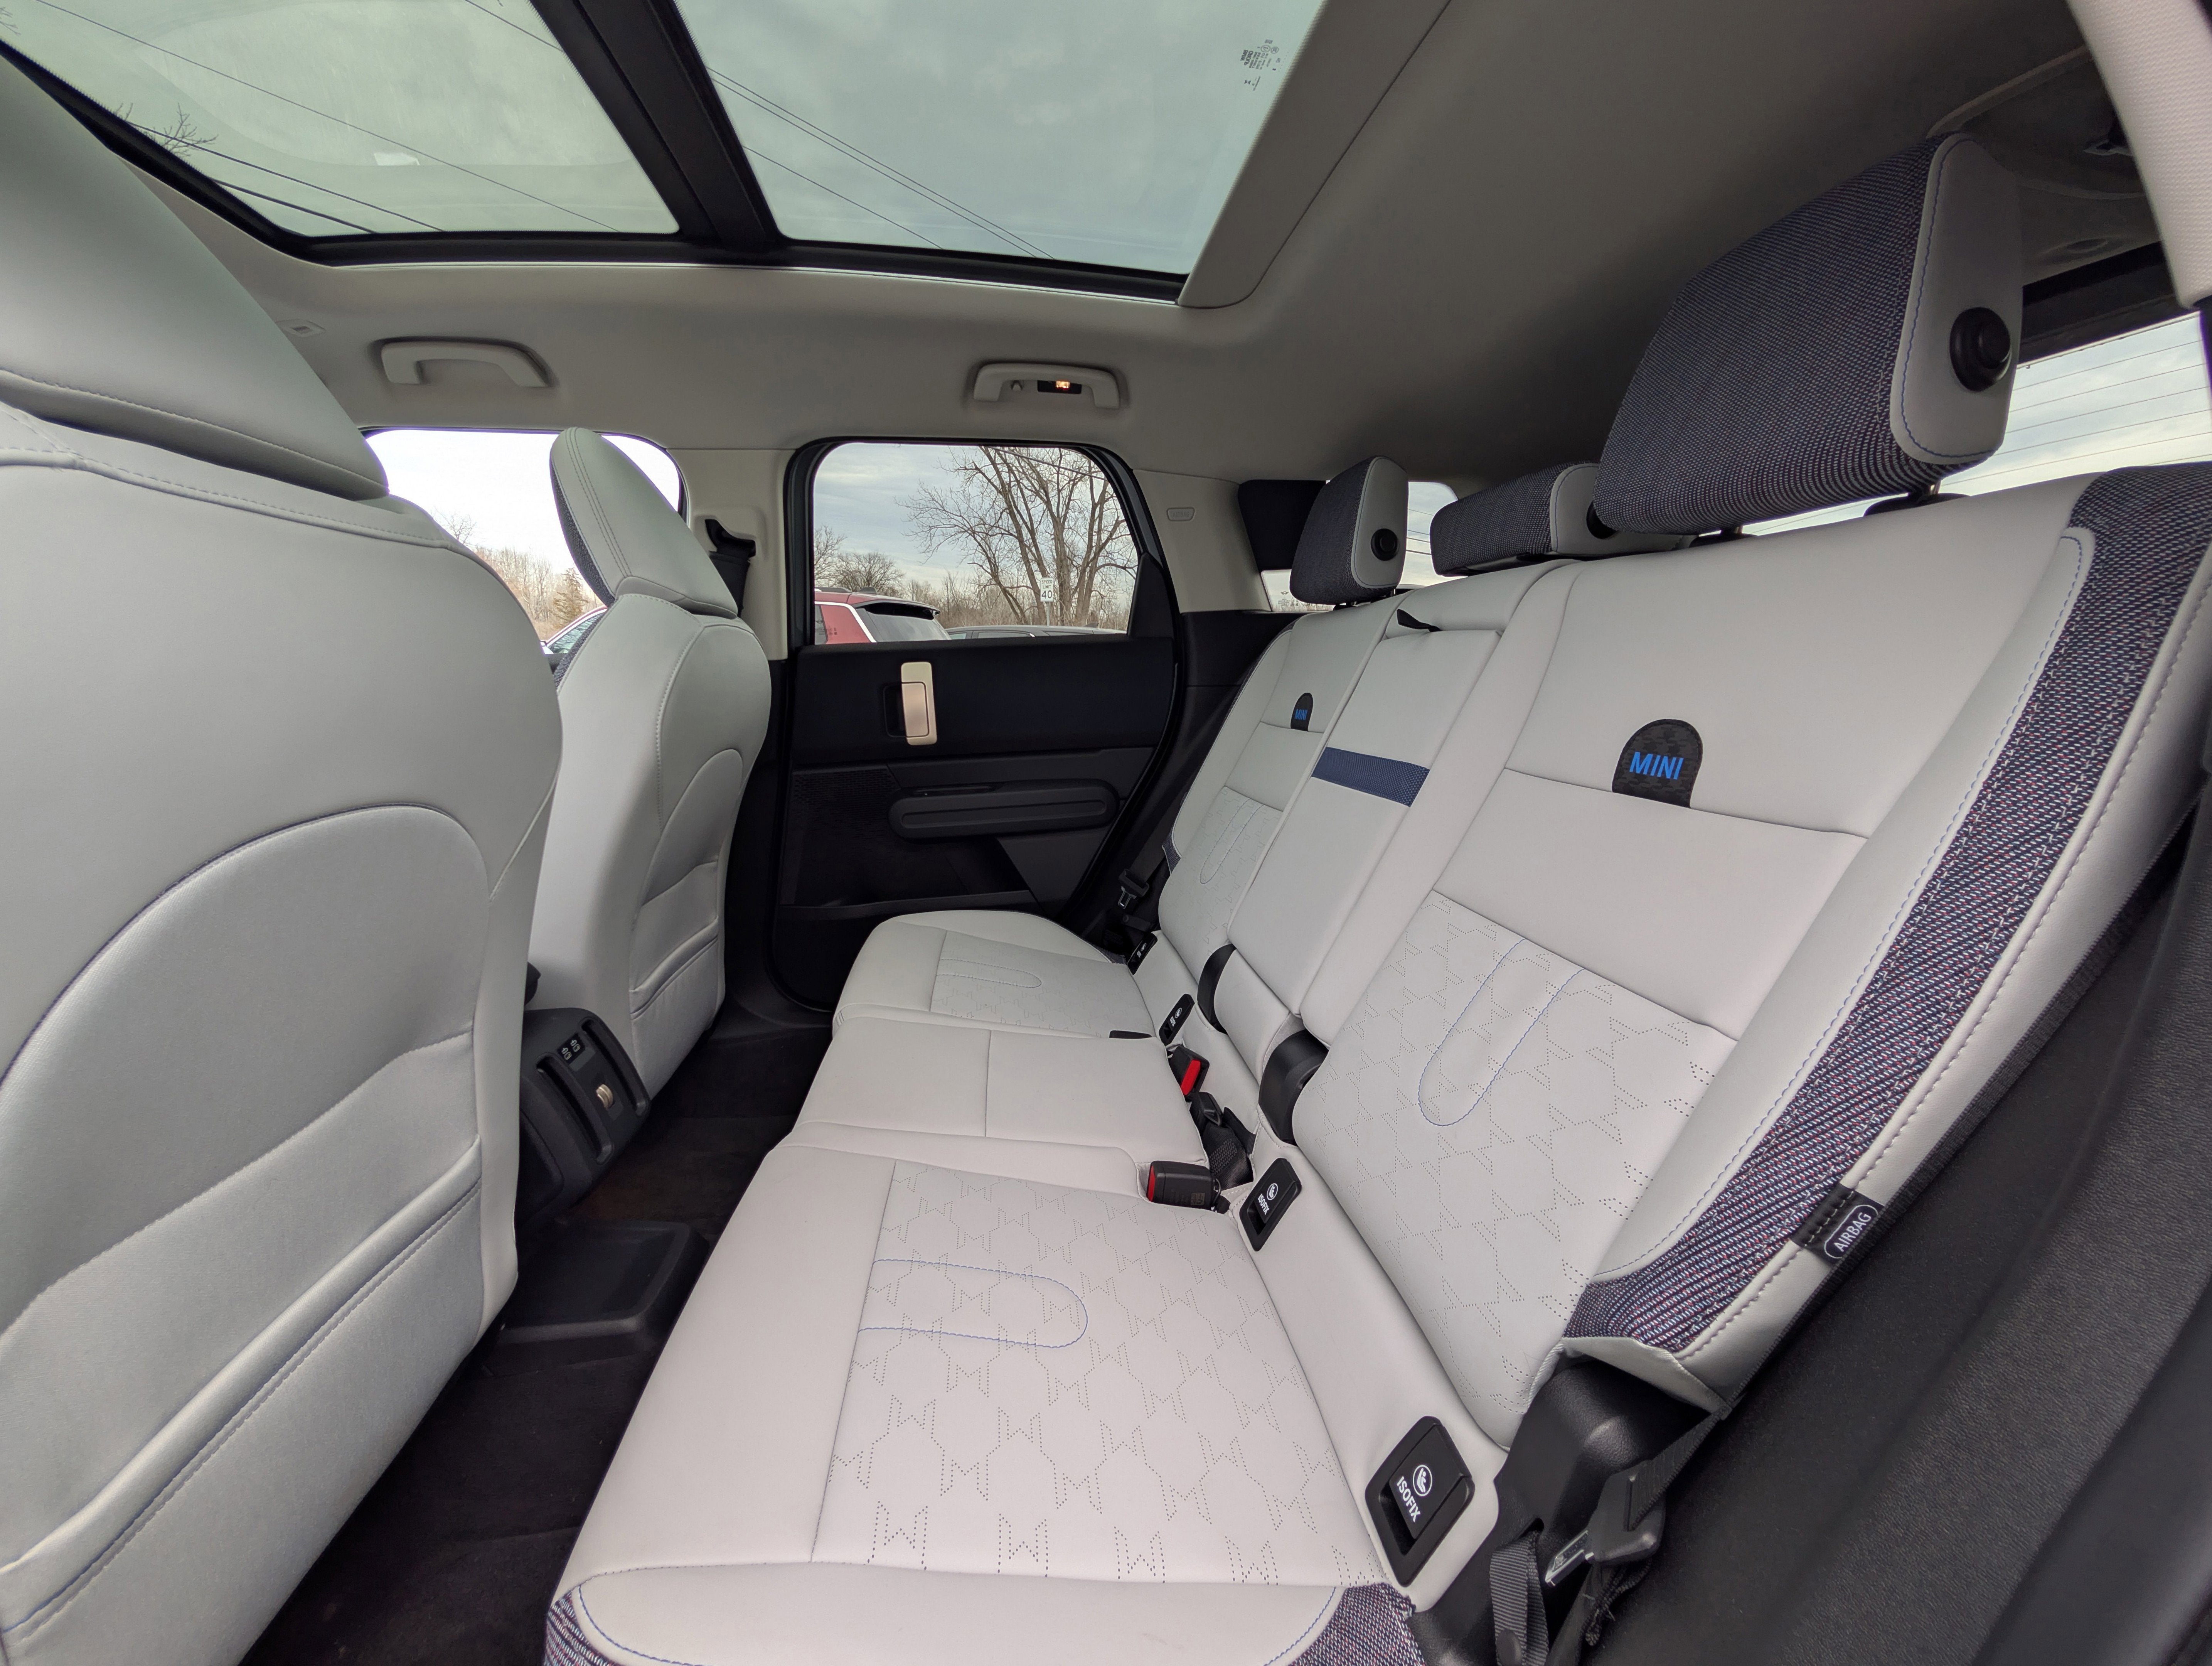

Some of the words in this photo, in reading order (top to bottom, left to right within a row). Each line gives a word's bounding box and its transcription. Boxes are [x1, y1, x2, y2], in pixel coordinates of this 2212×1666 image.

[1041, 590, 1053, 599] 40
[1294, 708, 1308, 720] MINI
[1629, 752, 1684, 780] MINI
[1258, 1193, 1270, 1215] ISOFIX
[1834, 1212, 1871, 1252] AIRBAG
[1397, 1476, 1421, 1523] ISOFIX
